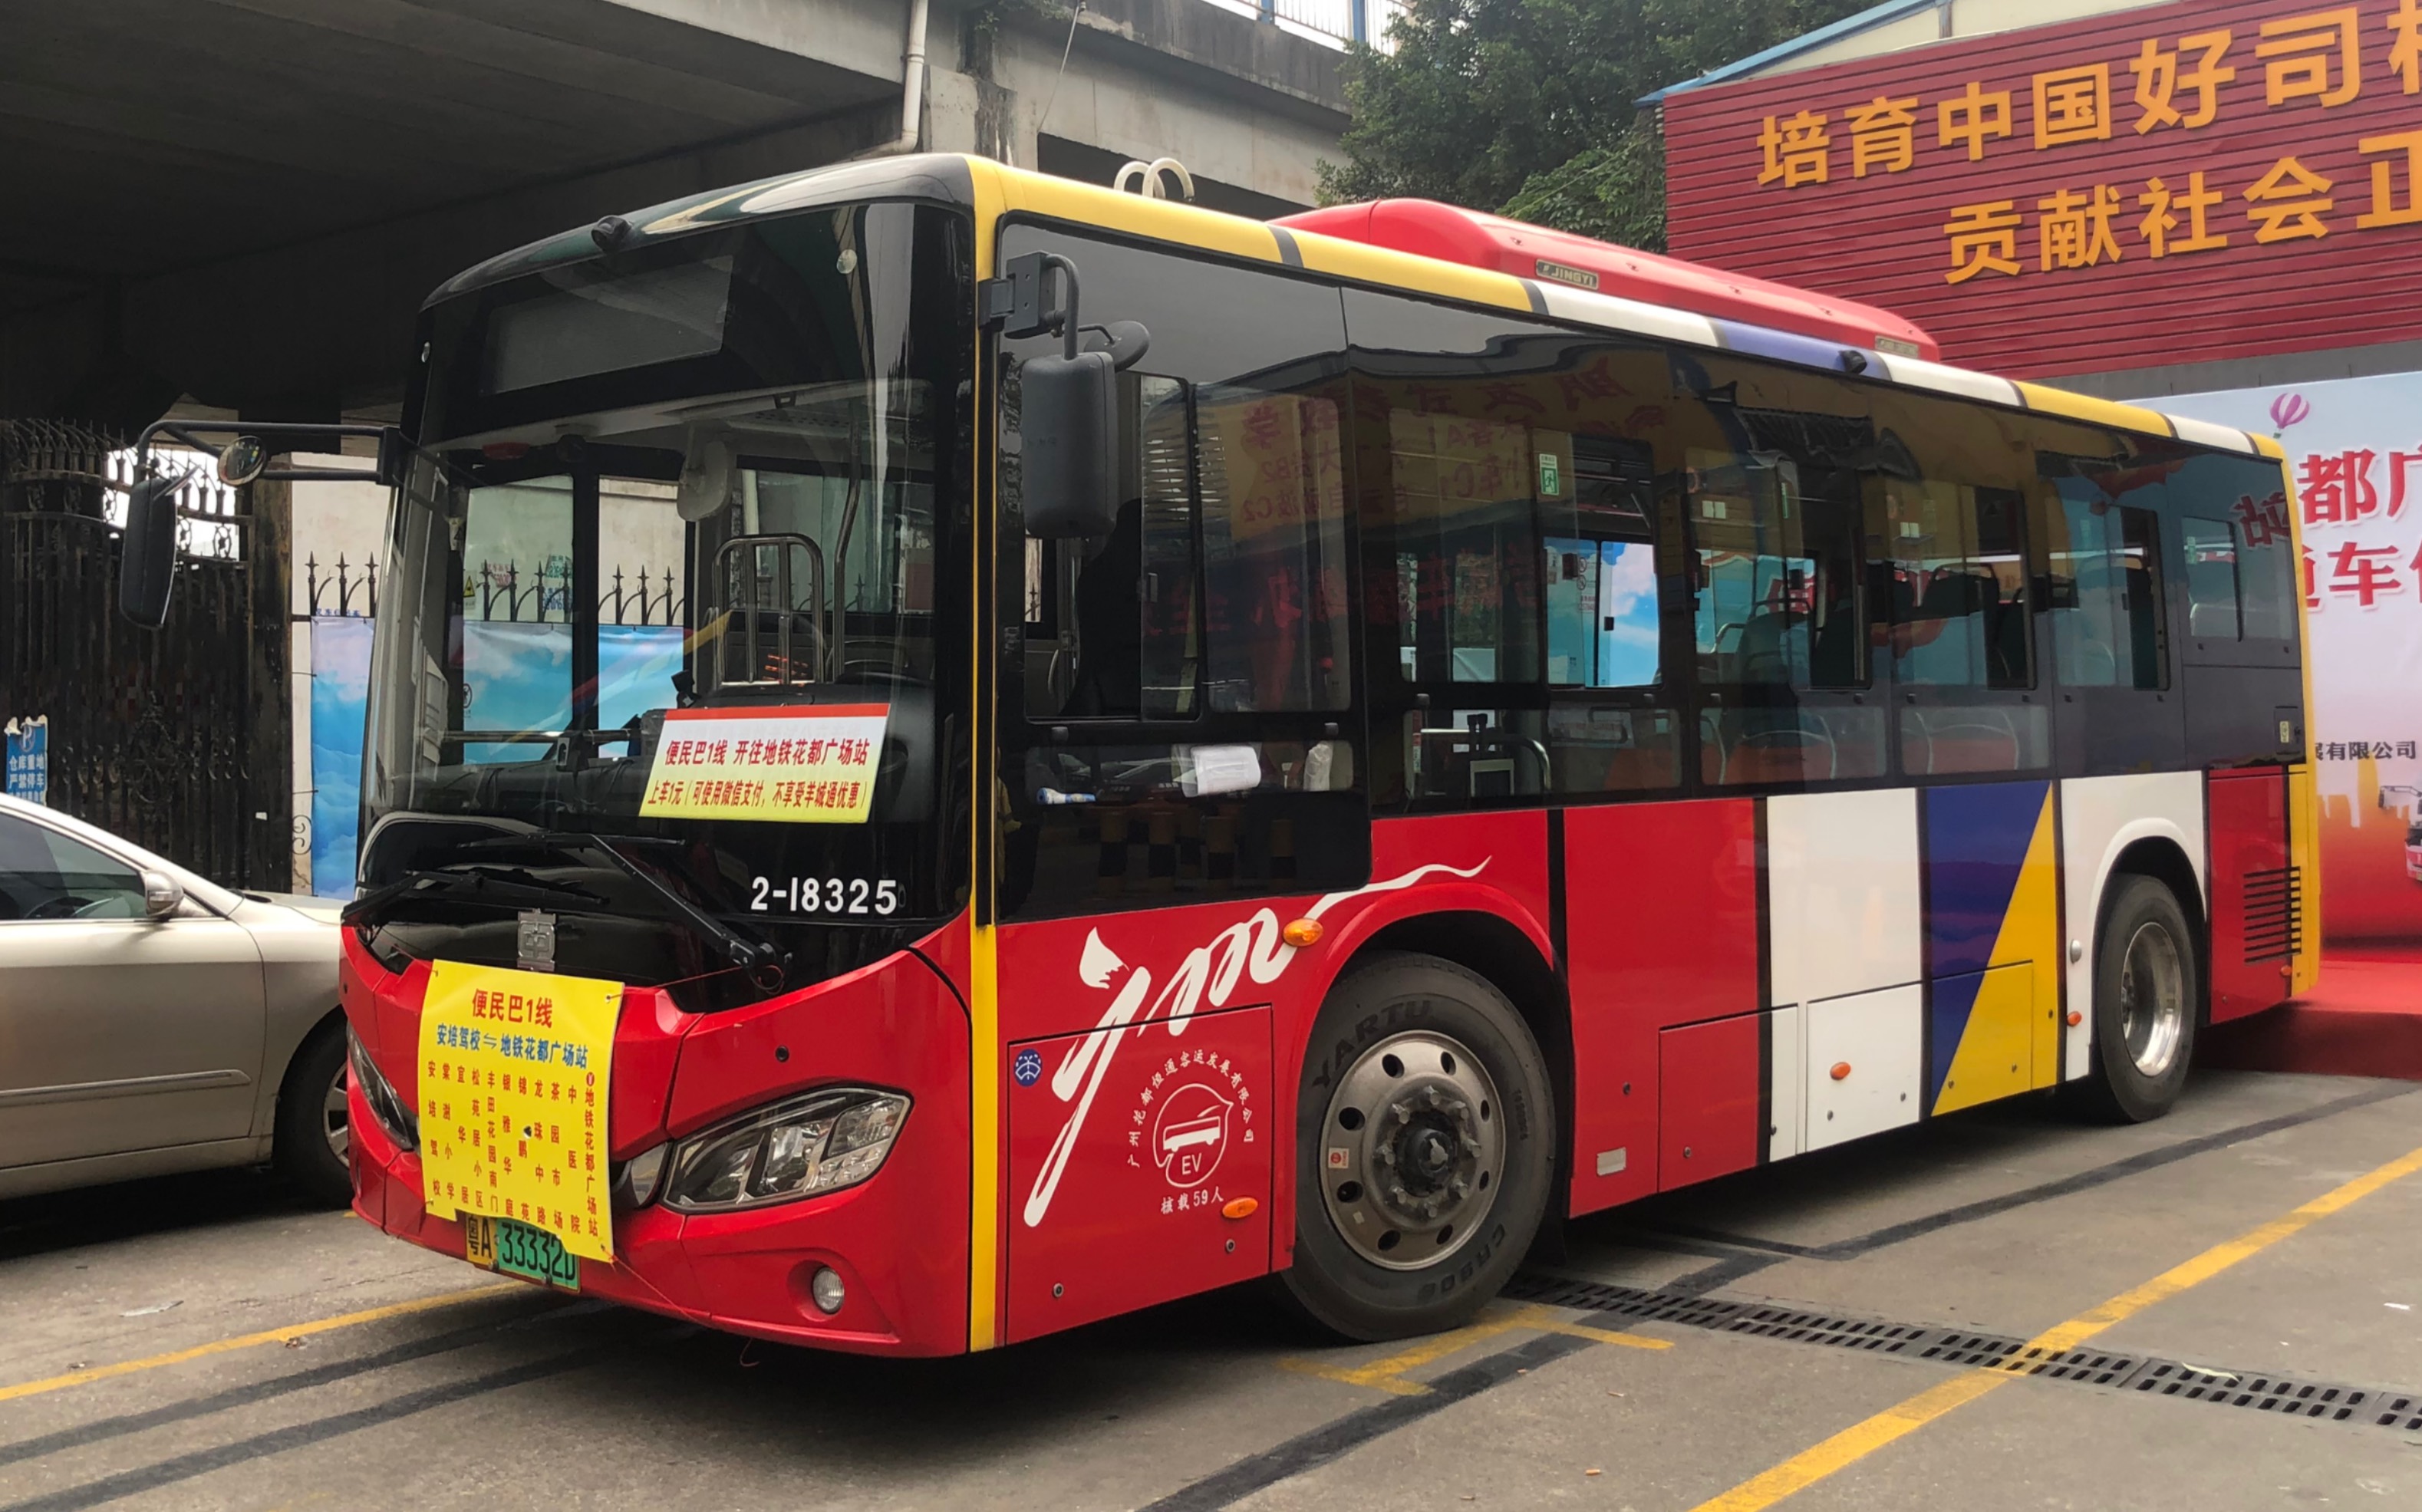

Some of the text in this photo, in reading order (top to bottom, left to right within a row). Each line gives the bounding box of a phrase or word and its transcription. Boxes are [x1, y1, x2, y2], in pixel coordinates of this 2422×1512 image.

[9, 754, 44, 771] 仓库重地
[664, 737, 870, 766] 便民巴1线 开往地铁花都广场站
[9, 773, 44, 789] 严禁停车
[750, 876, 898, 915] 2-18325
[472, 988, 554, 1029] 便民巴1线
[437, 1023, 588, 1069] 安培驾校 地铁花都广场站
[428, 1060, 442, 1197] 安培驾校
[502, 1073, 515, 1217] 银雅华庭
[533, 1079, 547, 1226] 龙珠中路
[549, 1082, 563, 1229] 茶园市场
[567, 1085, 582, 1234] 中医院
[584, 1088, 599, 1237] 地铁花都广场站
[1181, 1153, 1202, 1175] EV
[1160, 1186, 1224, 1215] 核载59人
